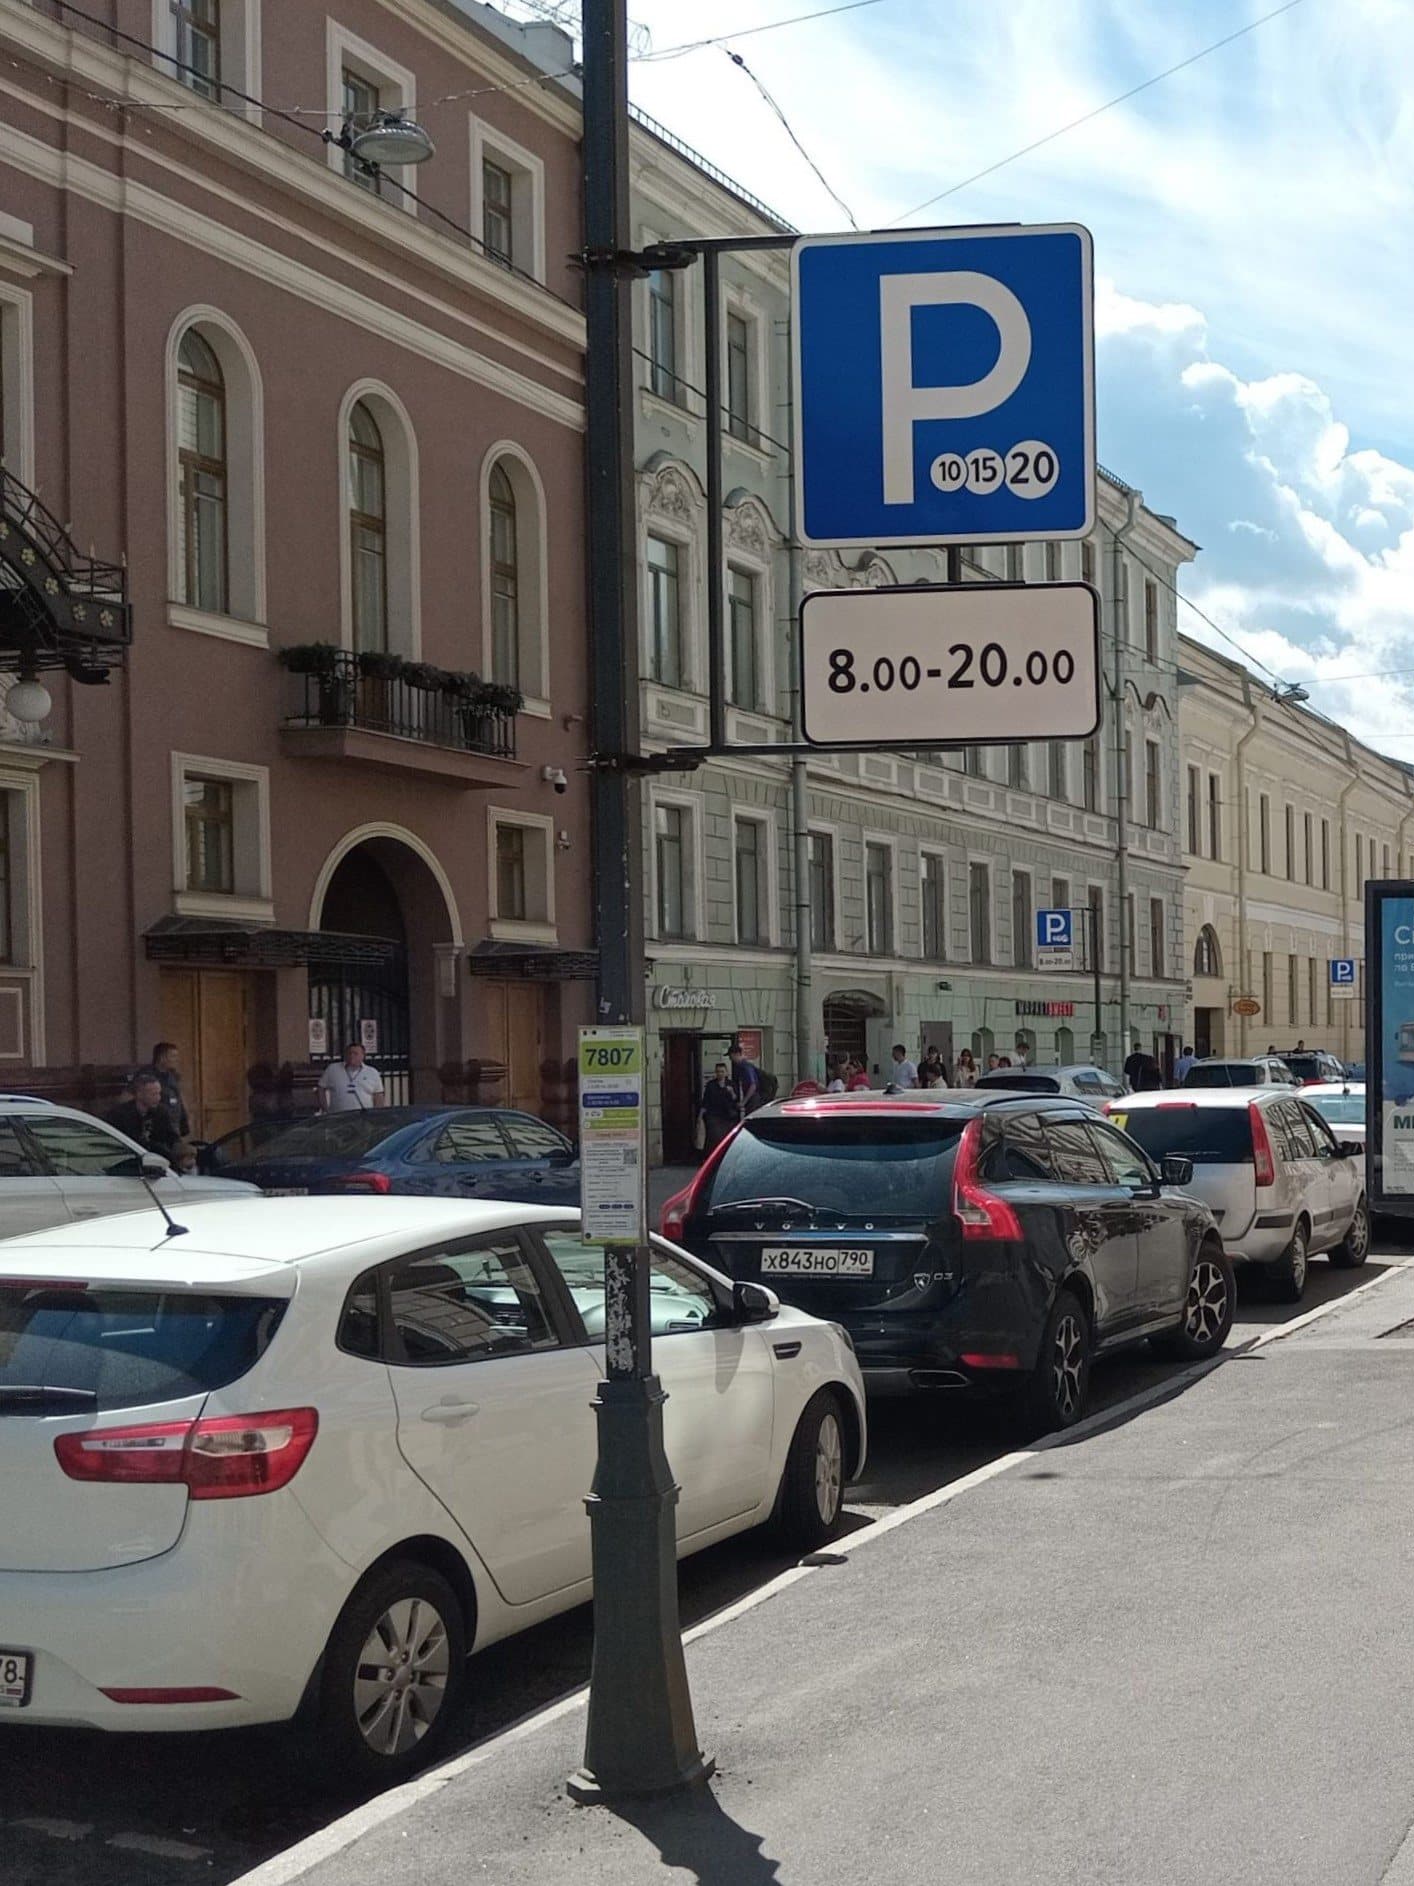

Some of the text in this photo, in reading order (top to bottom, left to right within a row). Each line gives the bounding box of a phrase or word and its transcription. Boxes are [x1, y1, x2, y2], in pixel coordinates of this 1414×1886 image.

[879, 270, 1032, 505] P
[938, 450, 1054, 484] 10 15 20
[828, 642, 1074, 693] 8.00-20.00
[1046, 914, 1066, 943] P
[1394, 952, 1414, 961] при
[1337, 961, 1351, 981] P
[585, 1047, 635, 1067] 7807
[754, 1222, 874, 1230] VOLVO
[841, 1252, 868, 1266] 790
[0, 1658, 18, 1684] 8
